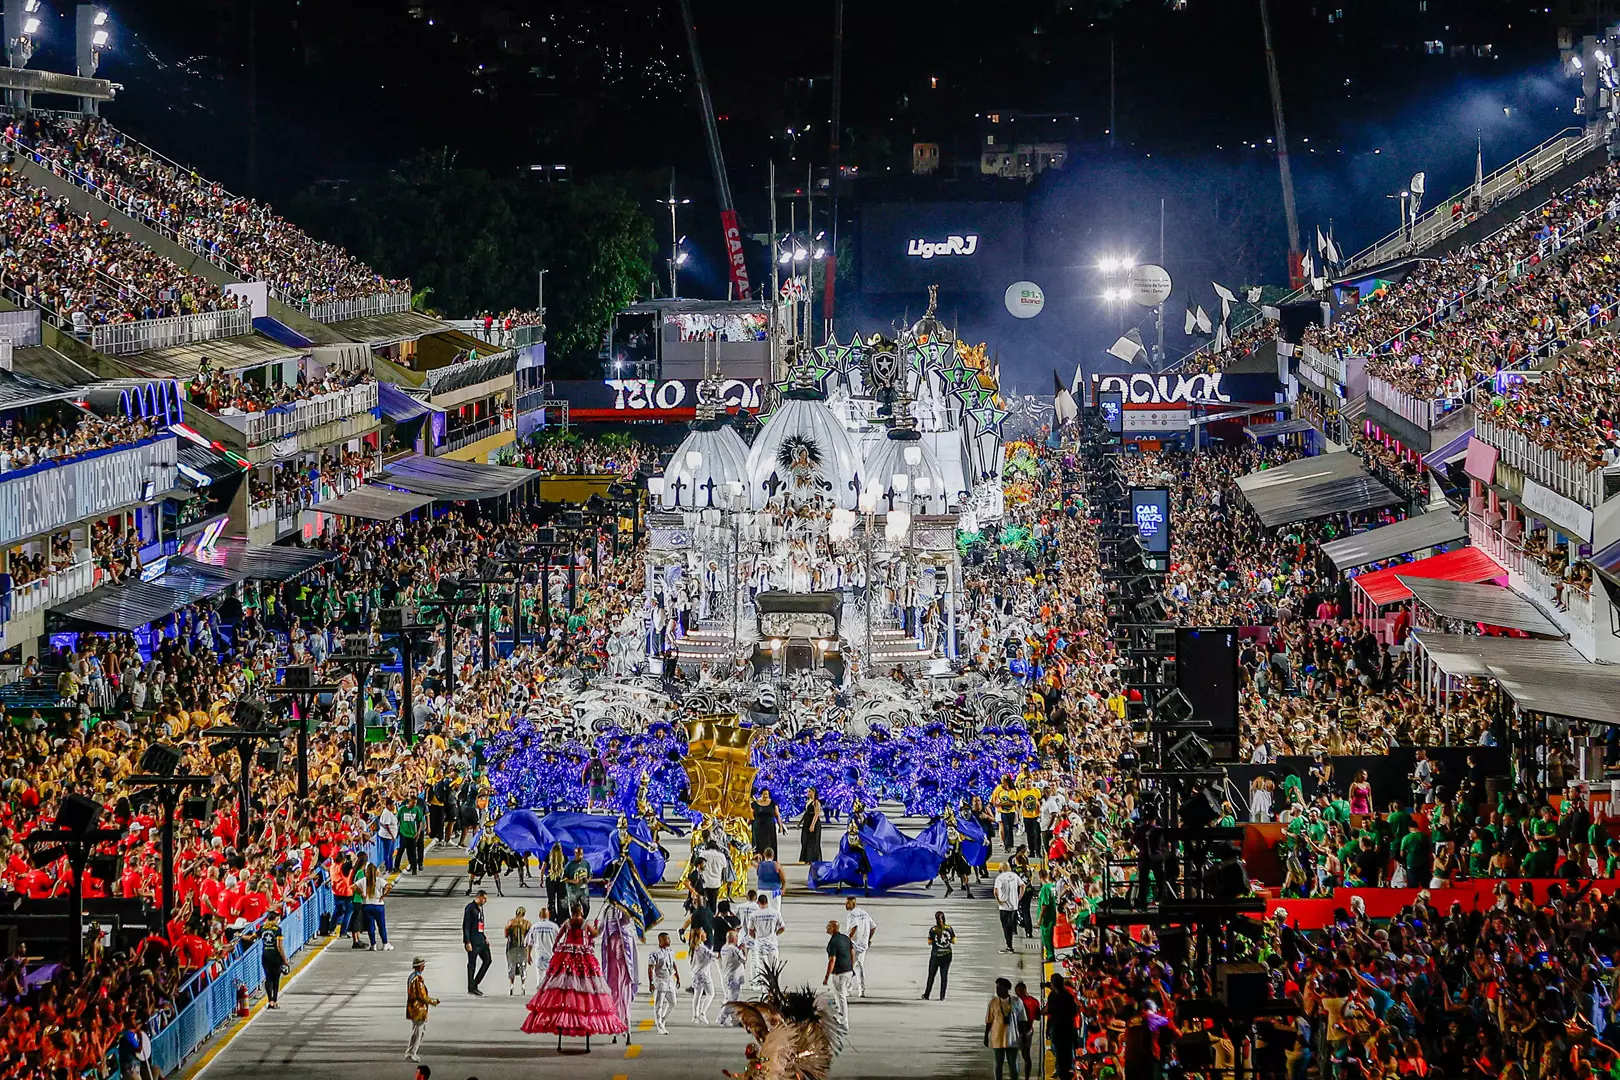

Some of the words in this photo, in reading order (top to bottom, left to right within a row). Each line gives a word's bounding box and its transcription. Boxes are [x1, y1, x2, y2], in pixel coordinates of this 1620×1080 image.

[907, 235, 978, 259] LigaRJ
[32, 470, 67, 533] SONHOS
[1136, 505, 1158, 514] CAR
